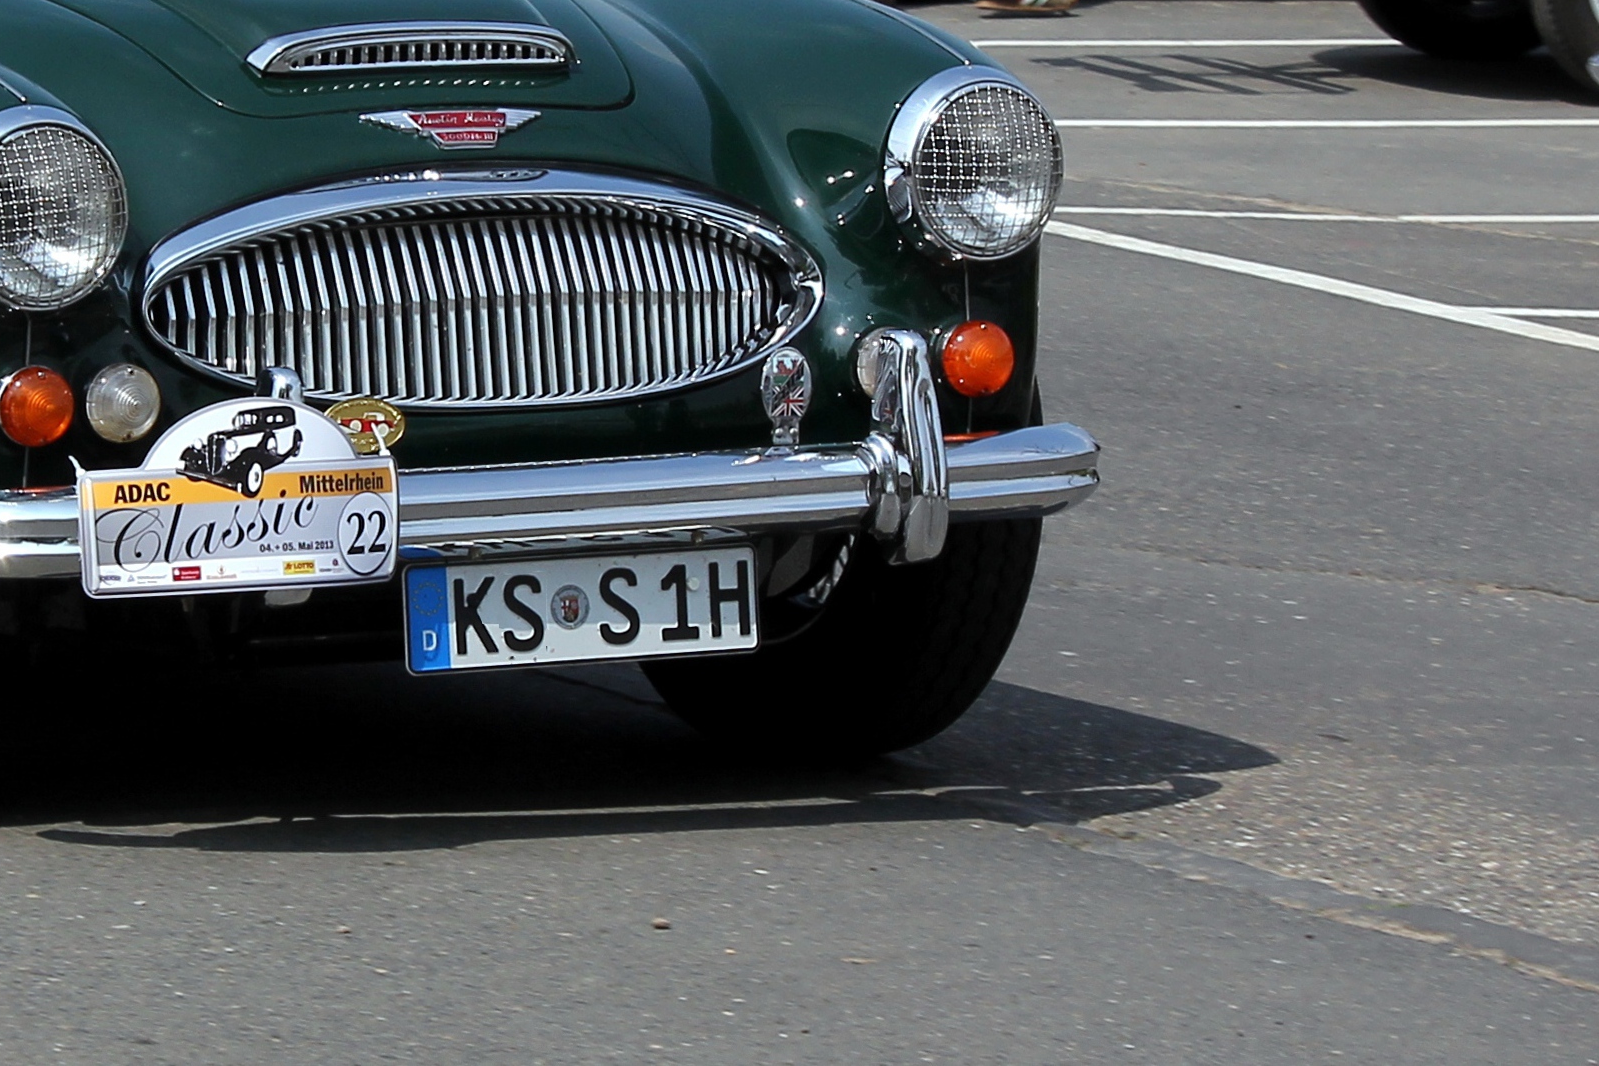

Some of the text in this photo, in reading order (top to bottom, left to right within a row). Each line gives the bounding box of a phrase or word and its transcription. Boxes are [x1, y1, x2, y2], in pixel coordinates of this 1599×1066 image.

[114, 471, 384, 504] ADAC Mittelrhein
[95, 489, 319, 573] Classic
[315, 540, 334, 550] 2013
[346, 509, 388, 556] 22
[453, 574, 545, 656] KS
[422, 630, 438, 652] D
